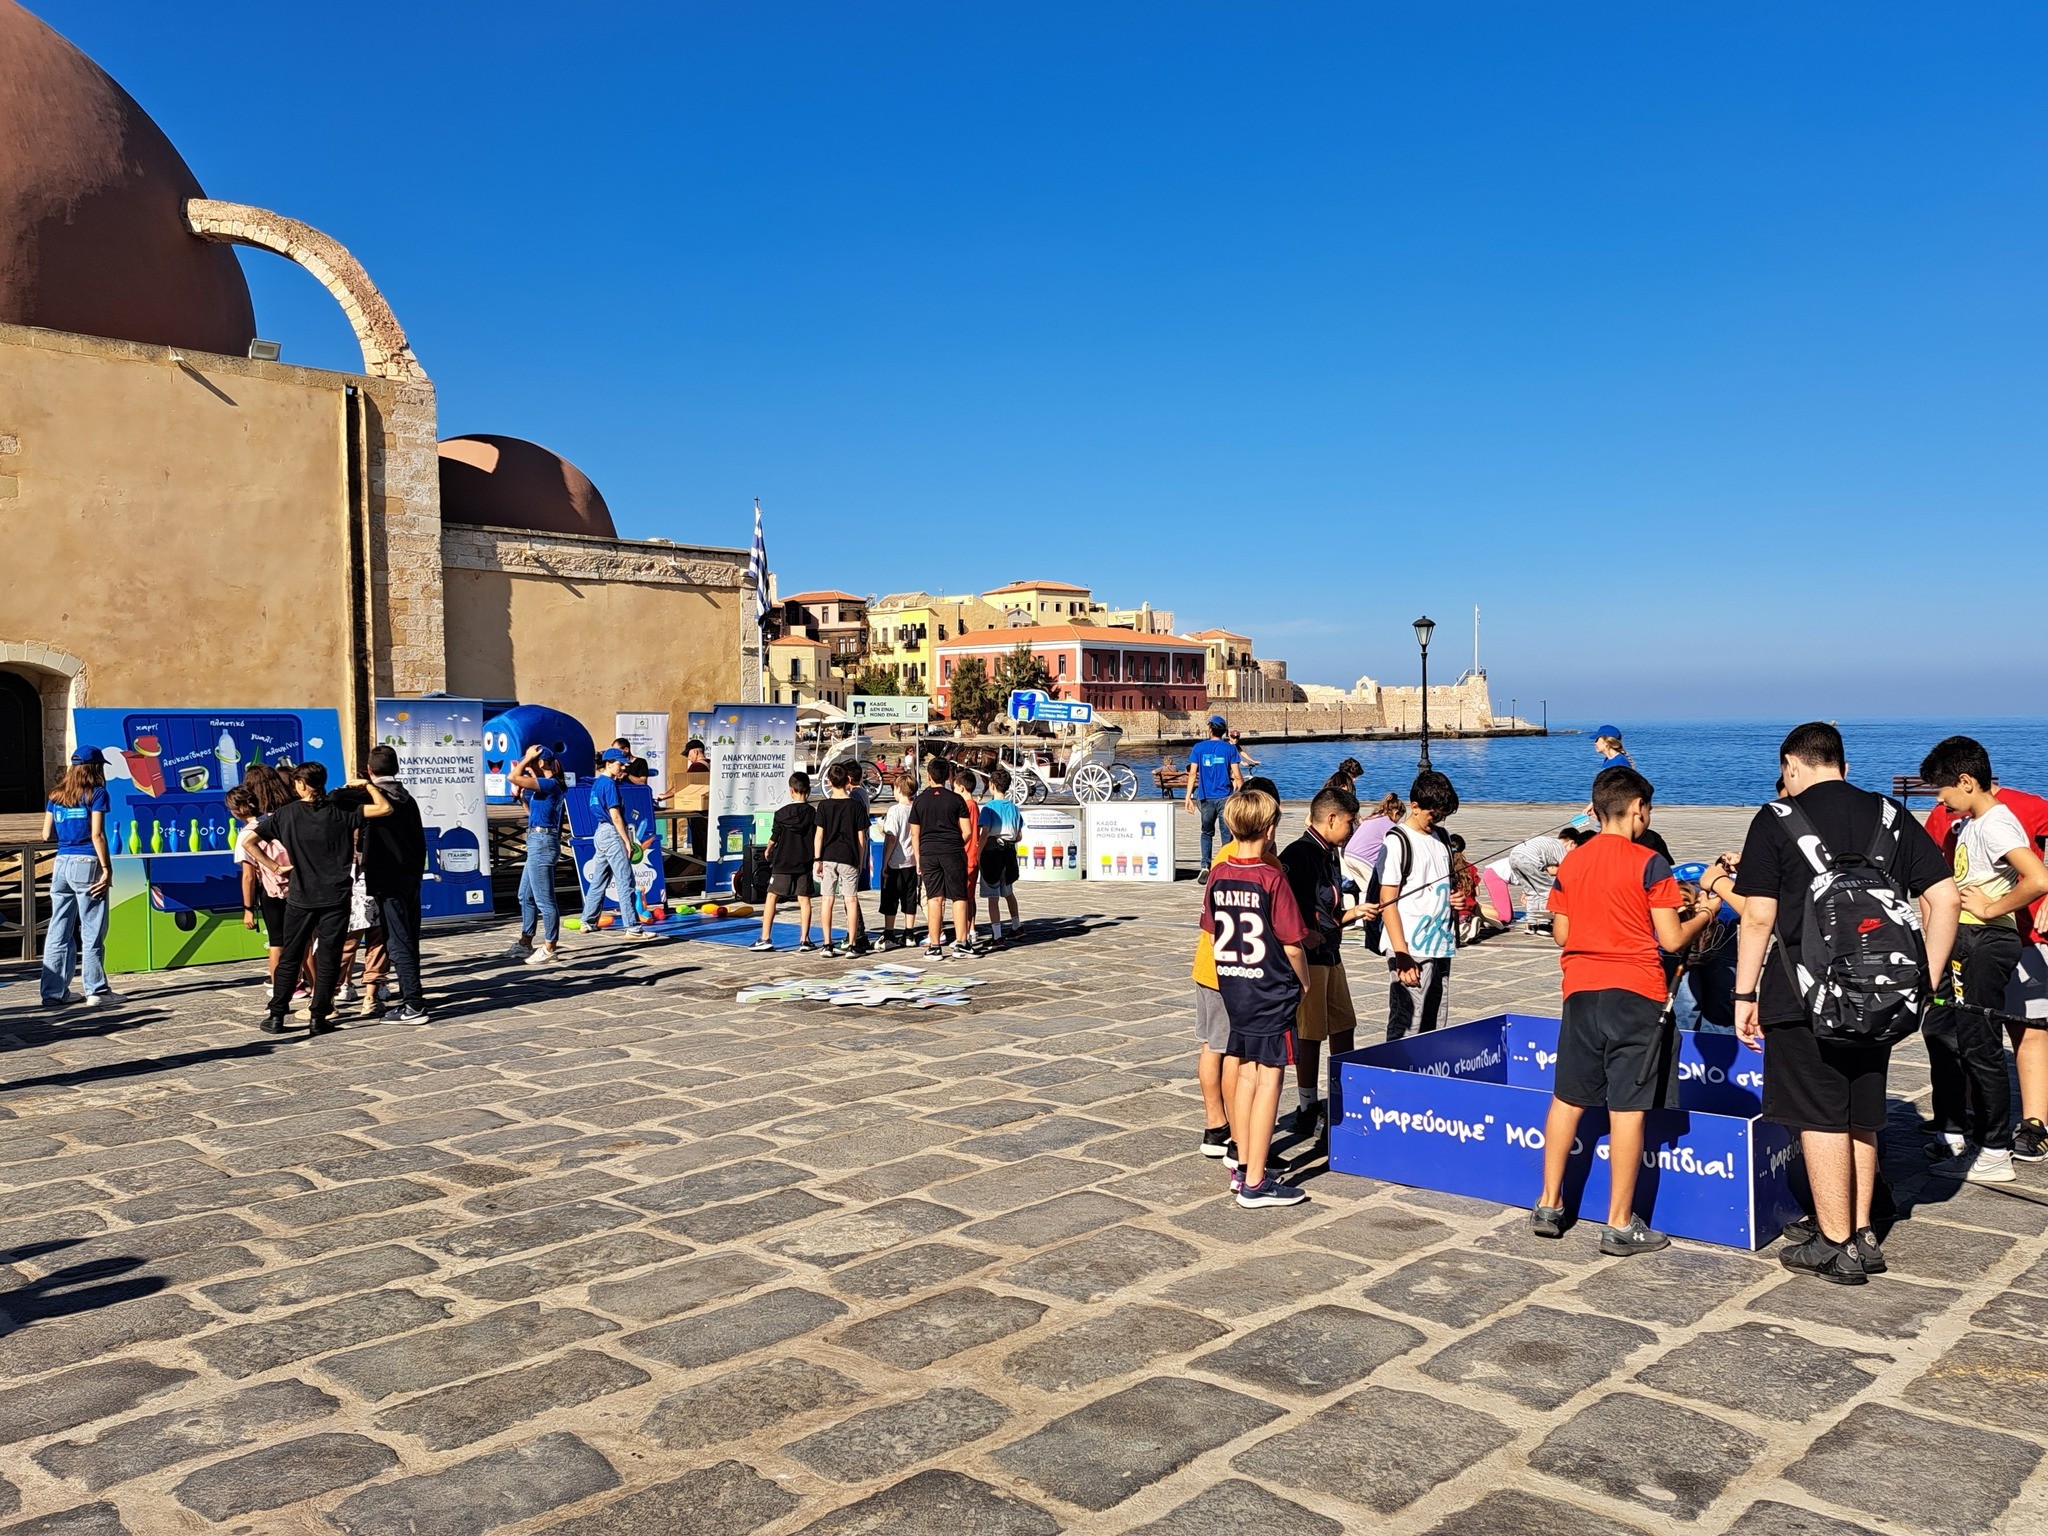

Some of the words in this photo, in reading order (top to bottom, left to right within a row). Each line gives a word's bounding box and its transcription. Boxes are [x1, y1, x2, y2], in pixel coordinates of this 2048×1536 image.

[136, 723, 159, 732] χαρτί
[646, 750, 657, 759] 95
[721, 753, 786, 762] ΑΝΑΚΥΚΛΩΝΟΥΜΕ
[399, 756, 474, 765] ΝΑΚΥΚΛΩΝΟΥΜΕ
[407, 767, 457, 775] ΣΥΣΚΕΥΑΣΙΕΣ
[458, 766, 475, 774] ΜΑΣ
[444, 776, 476, 784] ΚΑΔΟΥΣ
[1213, 910, 1266, 965] 23
[1454, 1044, 1501, 1075] σκουπίδια!
[1678, 1061, 1726, 1085] ΟΝΟ
[1505, 1122, 1584, 1156] ΜΟΟ
[1596, 1144, 1735, 1180] συπίδια!
